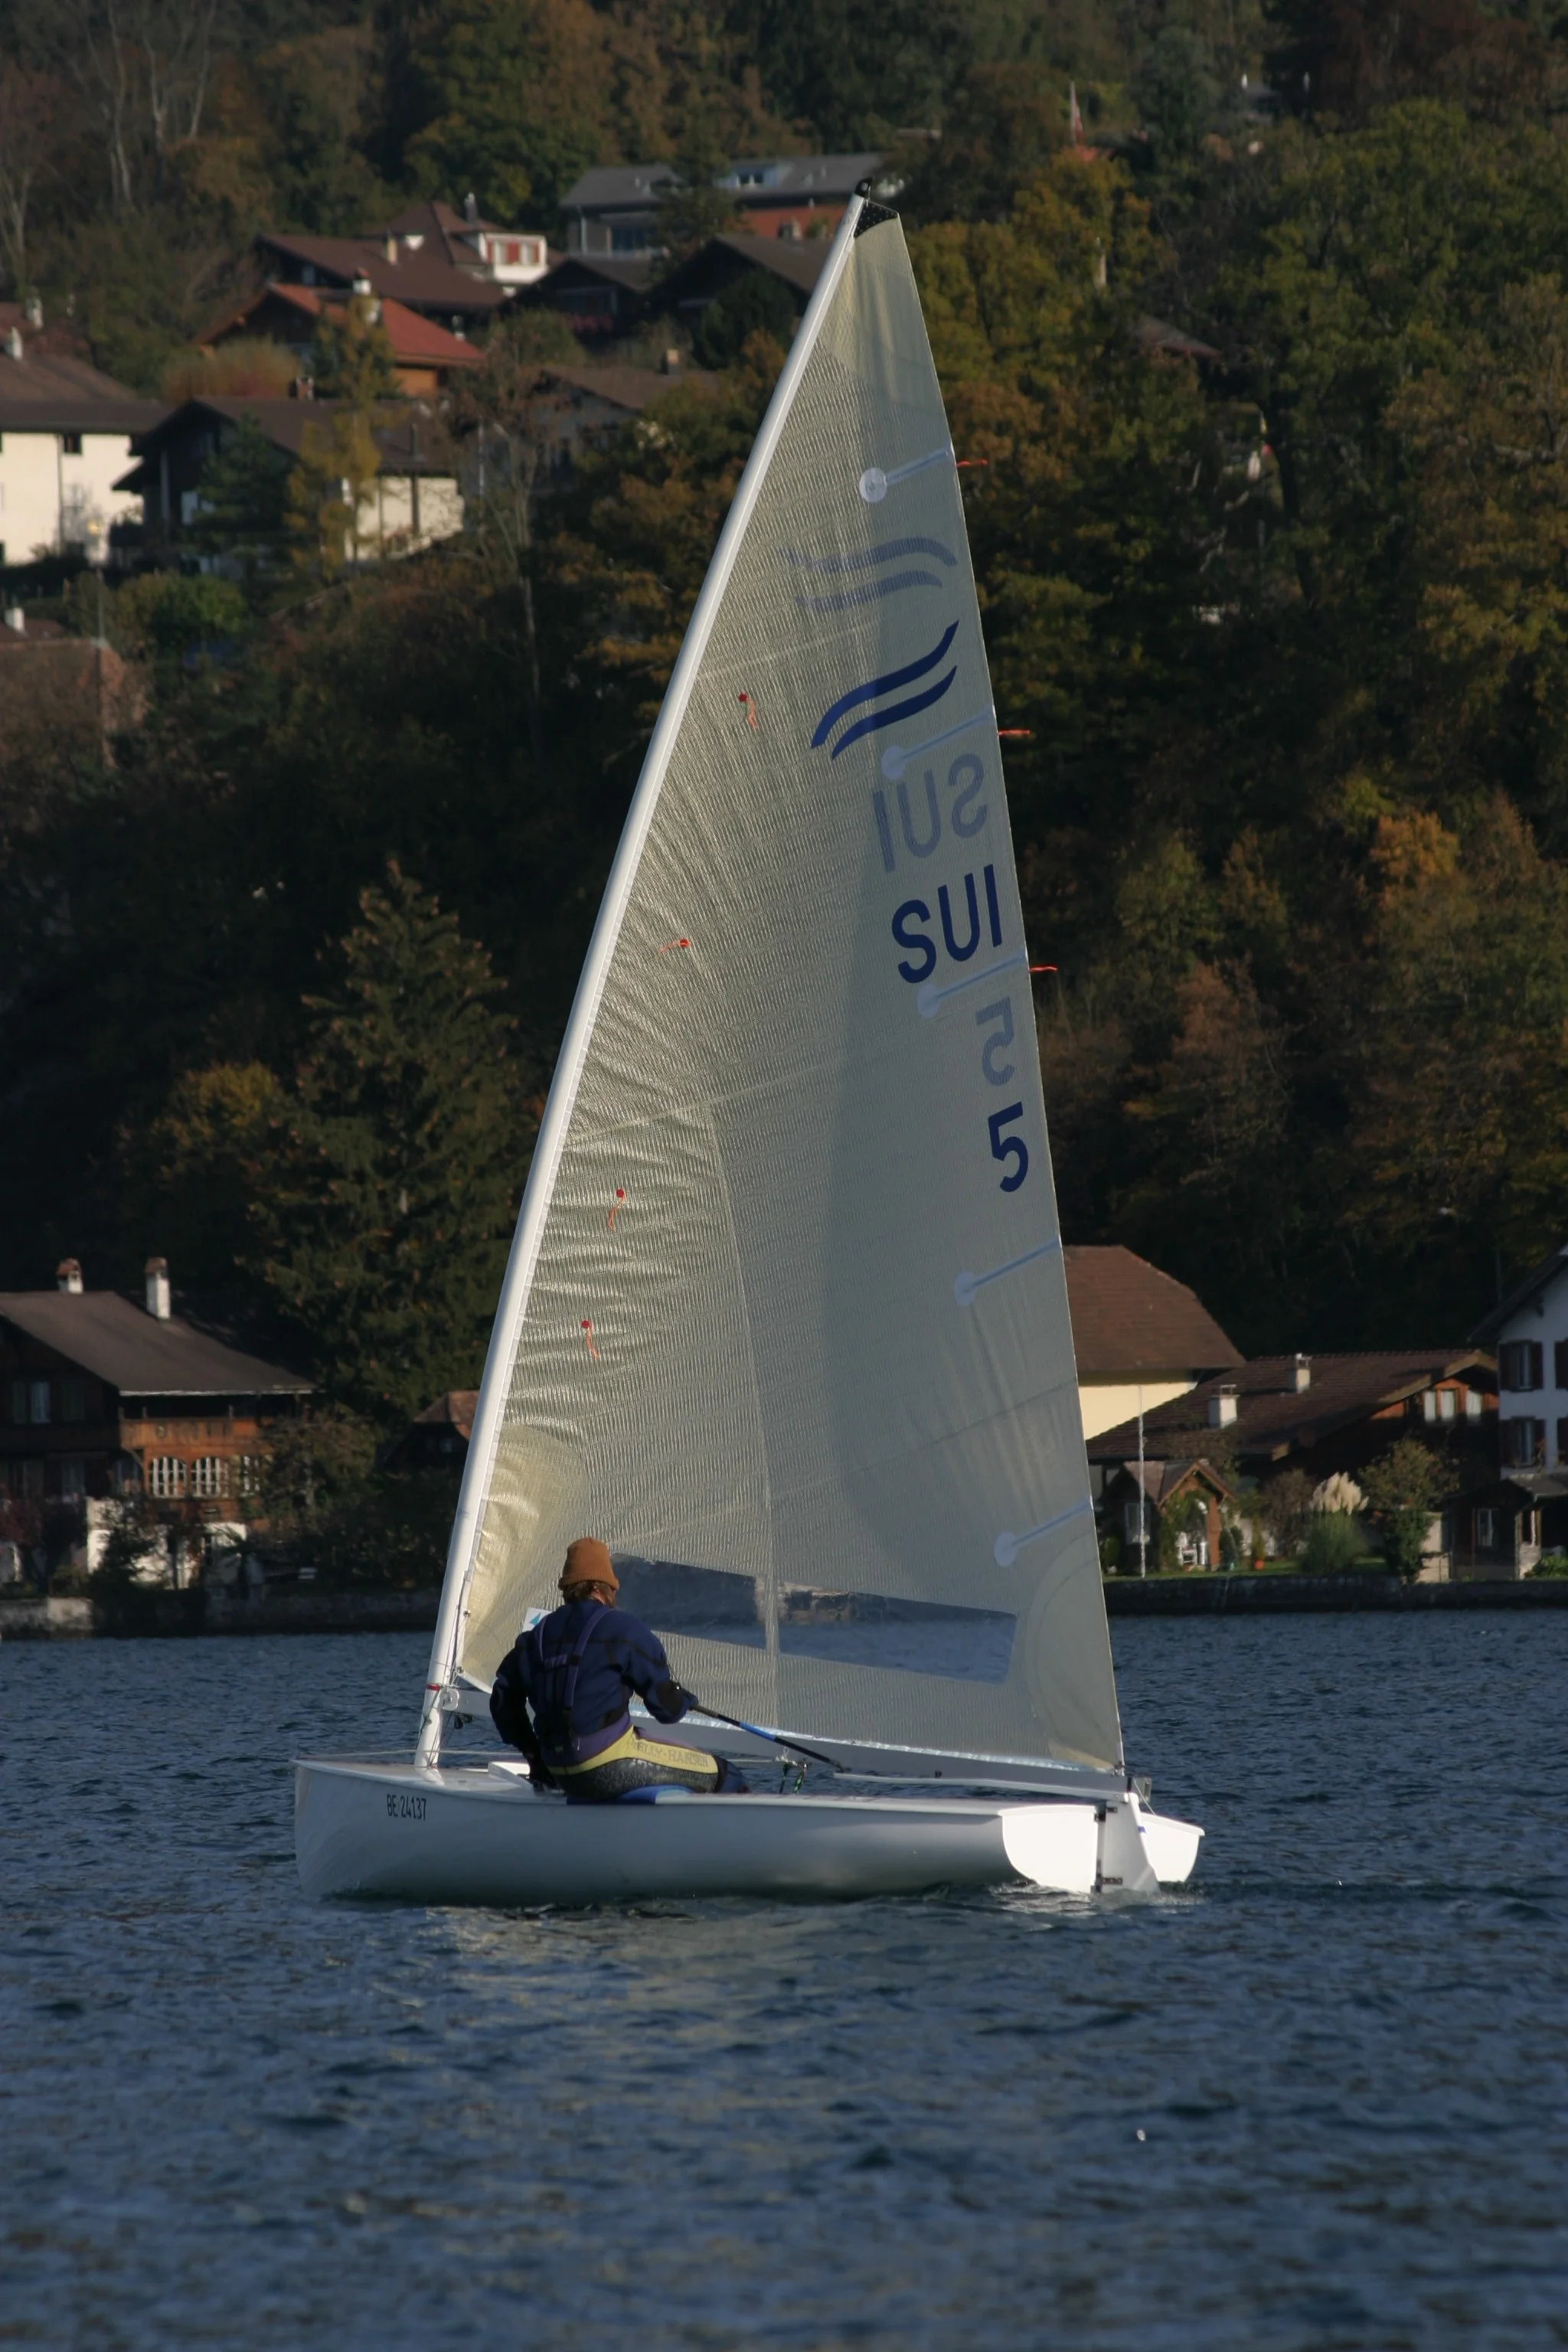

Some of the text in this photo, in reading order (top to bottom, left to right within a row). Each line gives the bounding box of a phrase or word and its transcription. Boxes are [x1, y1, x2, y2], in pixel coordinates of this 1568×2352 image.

[891, 864, 1002, 984] SUI
[988, 1101, 1028, 1193] 5
[387, 1794, 427, 1821] BE 24137
